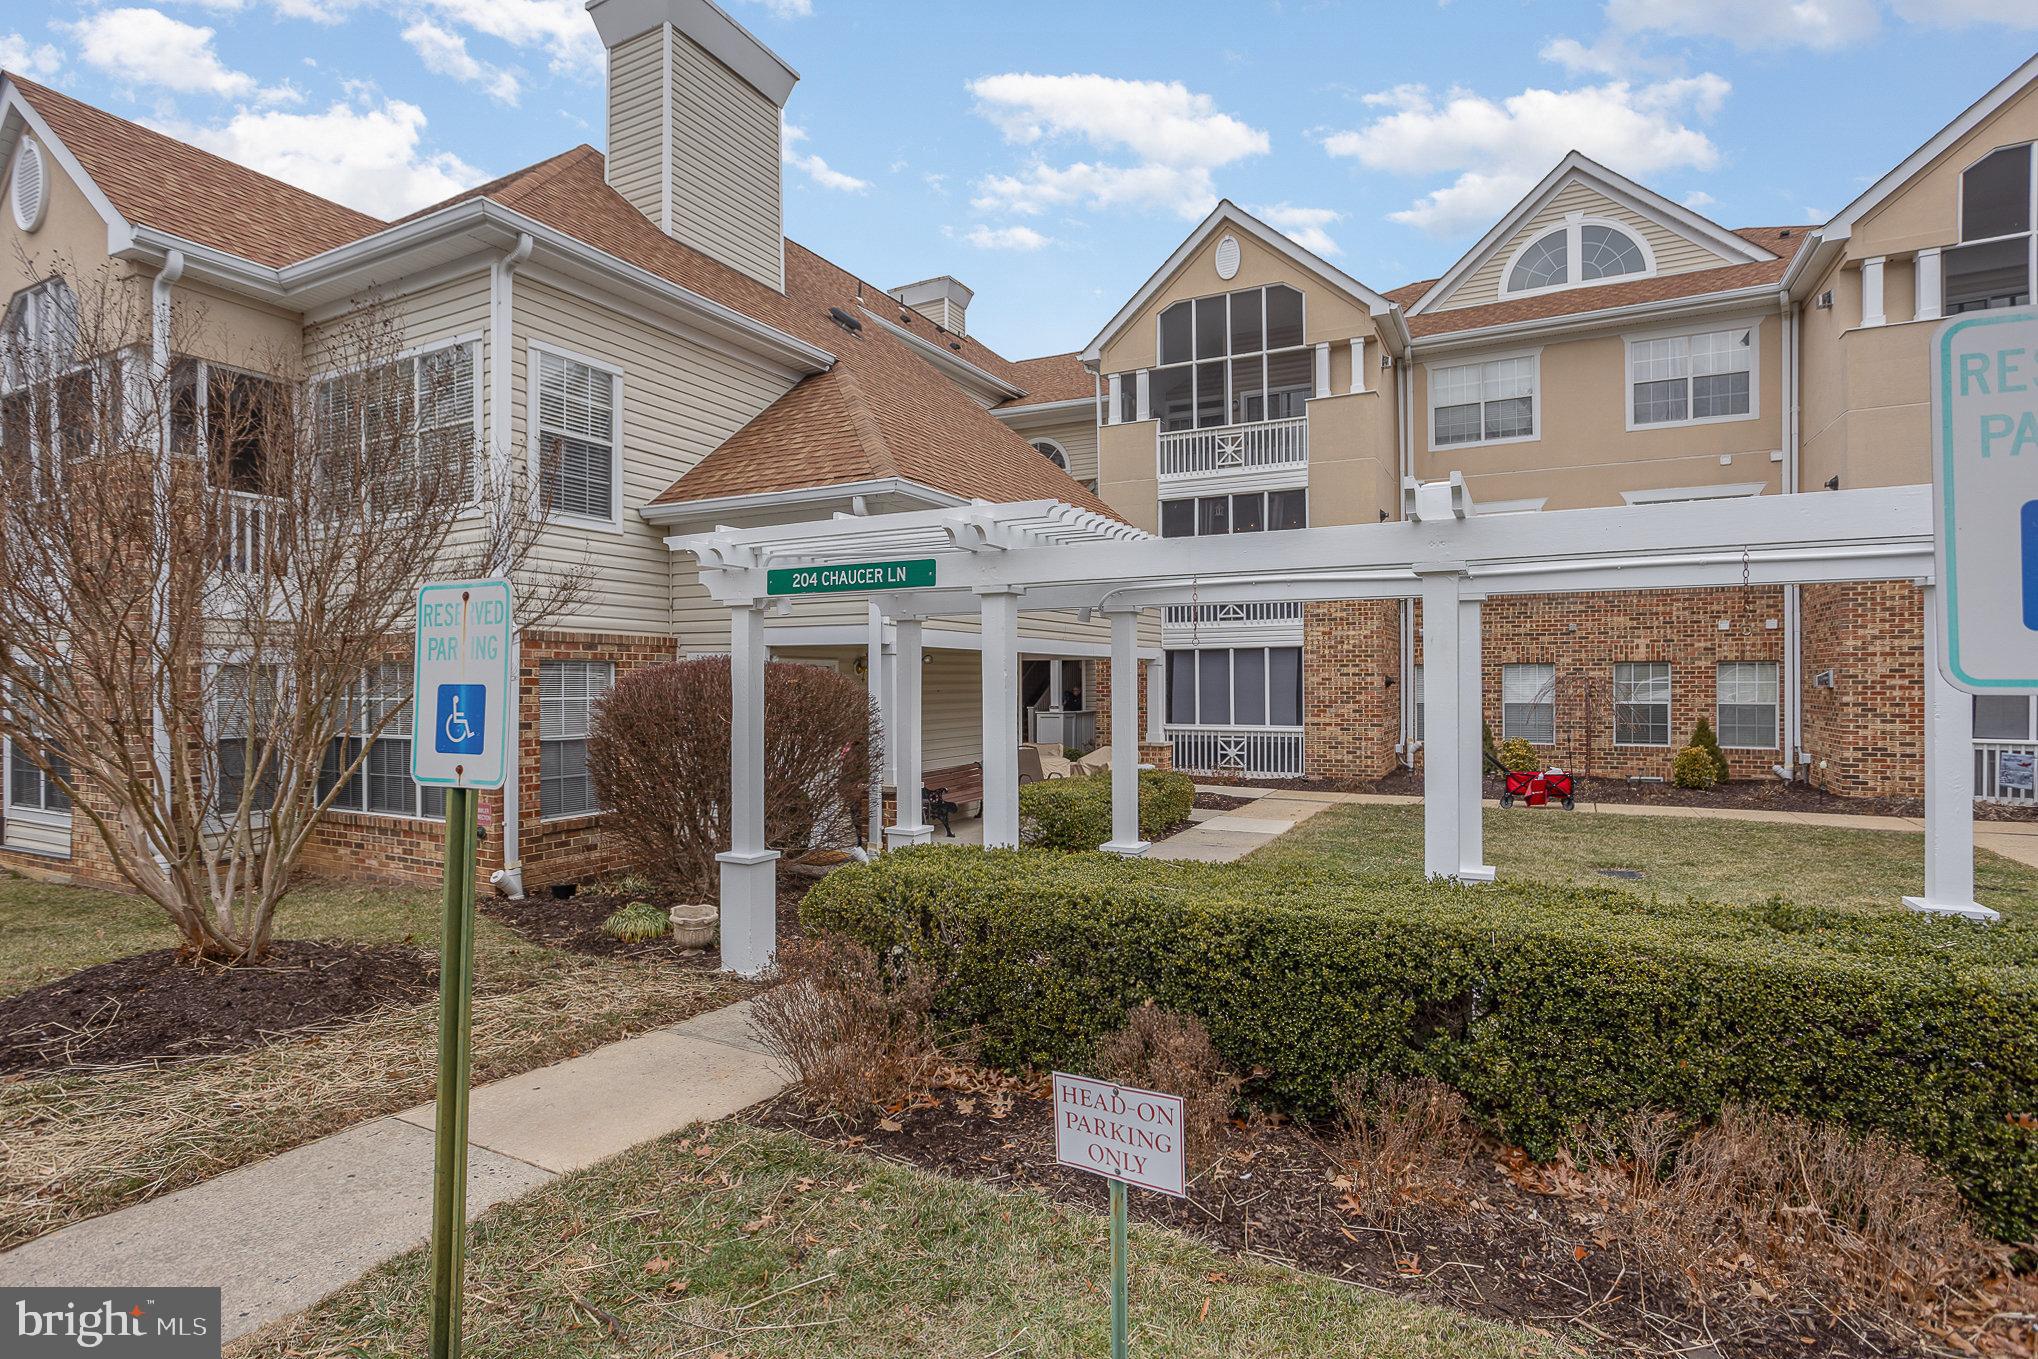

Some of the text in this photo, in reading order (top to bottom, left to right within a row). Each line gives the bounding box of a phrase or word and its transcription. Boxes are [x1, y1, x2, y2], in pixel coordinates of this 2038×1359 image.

[1960, 347, 2038, 396] RE
[792, 566, 906, 588] 204 CHAUCER LN
[428, 634, 498, 661] PARING
[1062, 1085, 1174, 1126] HEAD-ON
[1065, 1111, 1171, 1153] PARKING
[1088, 1143, 1147, 1175] ONLY
